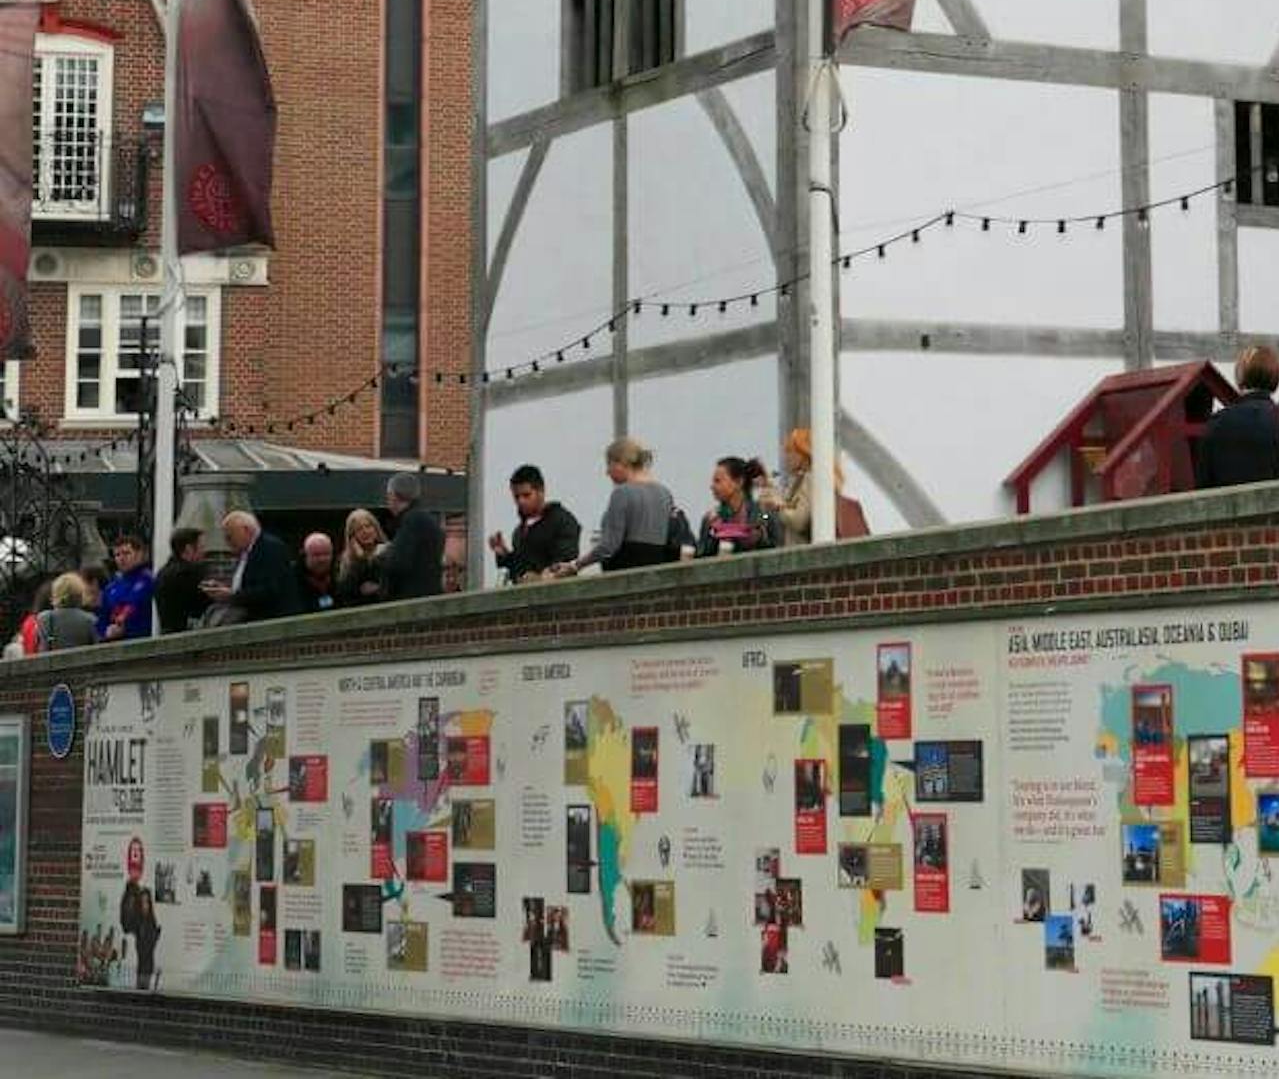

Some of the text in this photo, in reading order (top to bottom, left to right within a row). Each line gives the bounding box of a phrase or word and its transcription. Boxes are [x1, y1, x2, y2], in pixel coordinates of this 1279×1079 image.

[1031, 632, 1067, 652] MIDDLE
[1069, 630, 1093, 651] EAST,
[1163, 623, 1204, 644] OCEANIA
[86, 738, 147, 786] HAMLET
